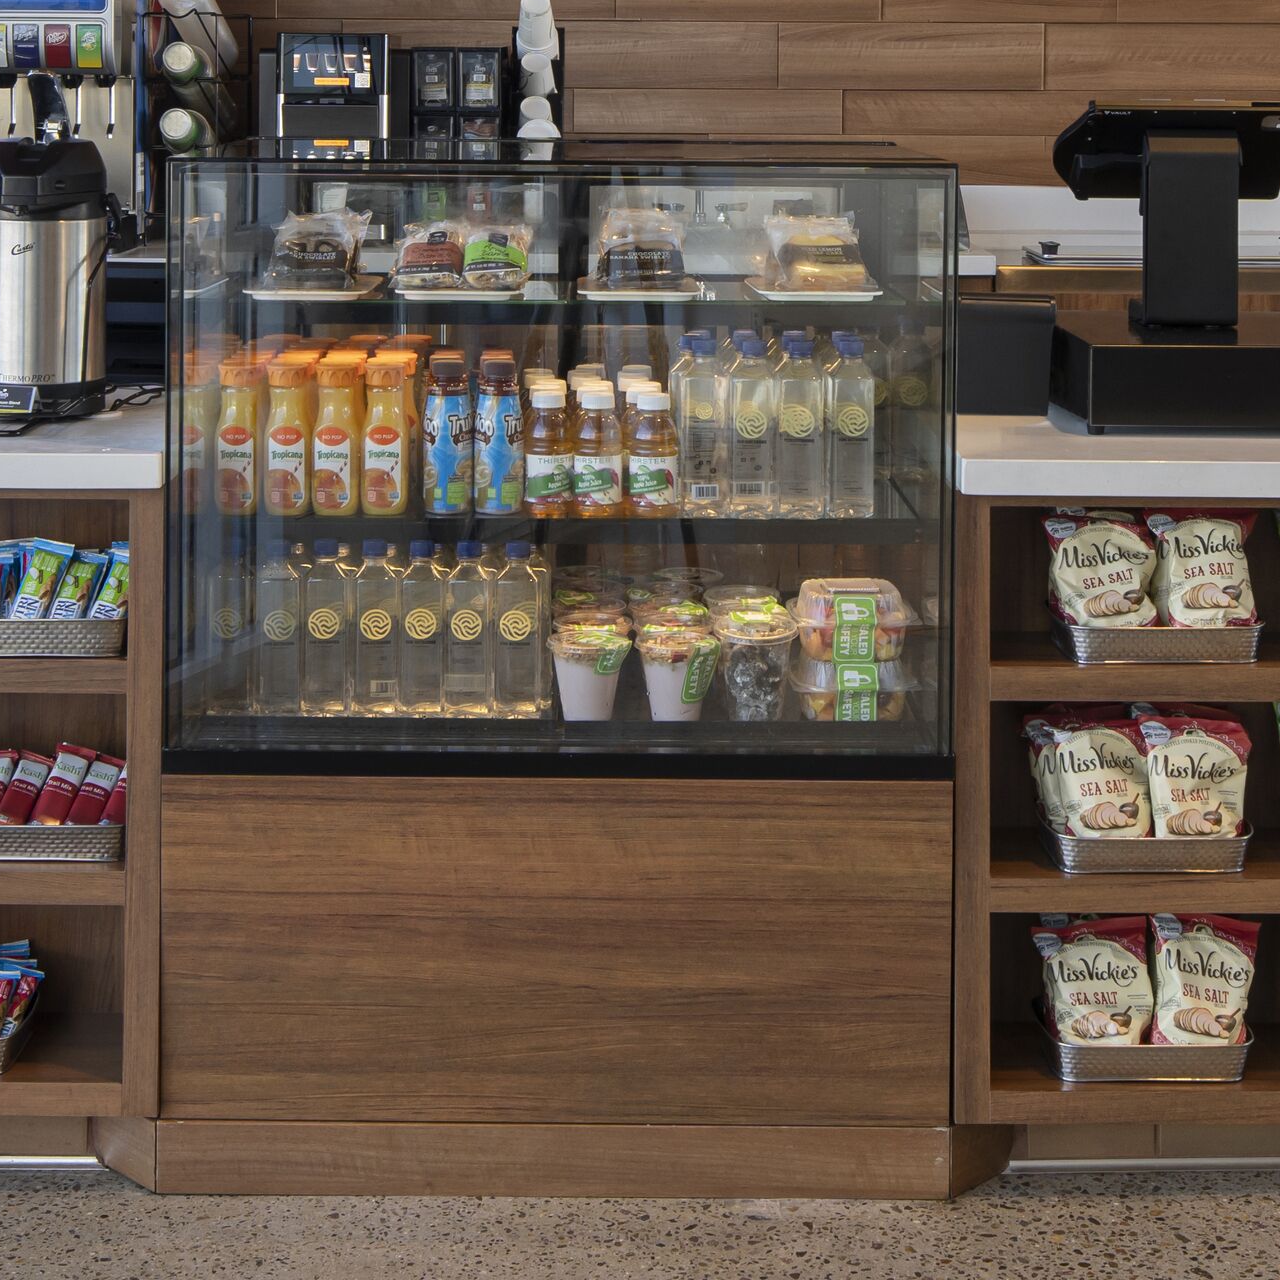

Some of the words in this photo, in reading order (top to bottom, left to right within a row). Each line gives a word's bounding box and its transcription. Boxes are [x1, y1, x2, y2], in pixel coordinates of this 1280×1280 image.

[11, 242, 37, 256] Curtis
[220, 449, 252, 460] Tropicana
[271, 450, 303, 461] Tropicana
[317, 450, 349, 461] Tropicana
[368, 449, 400, 460] Tropicana
[1059, 545, 1099, 570] Miss
[1083, 576, 1105, 590] SEA
[1109, 568, 1134, 585] SALT
[1184, 565, 1205, 579] SEA
[1208, 562, 1234, 576] SALT
[1060, 750, 1097, 774] Miss
[1090, 742, 1136, 775] Vickie's
[1150, 754, 1189, 778] Miss
[1185, 752, 1237, 784] Vickie's
[1080, 780, 1102, 797] SEA
[1106, 778, 1128, 794] SALT
[1171, 788, 1188, 802] SEA
[1190, 787, 1210, 802] SALT
[1080, 952, 1139, 987] Vickie's
[1164, 948, 1200, 974] Miss
[1195, 951, 1250, 988] Vickie's
[1070, 993, 1091, 1006] SEA
[1094, 991, 1118, 1005] SALT
[1183, 983, 1201, 998] SEA
[1204, 989, 1230, 1004] SALT
